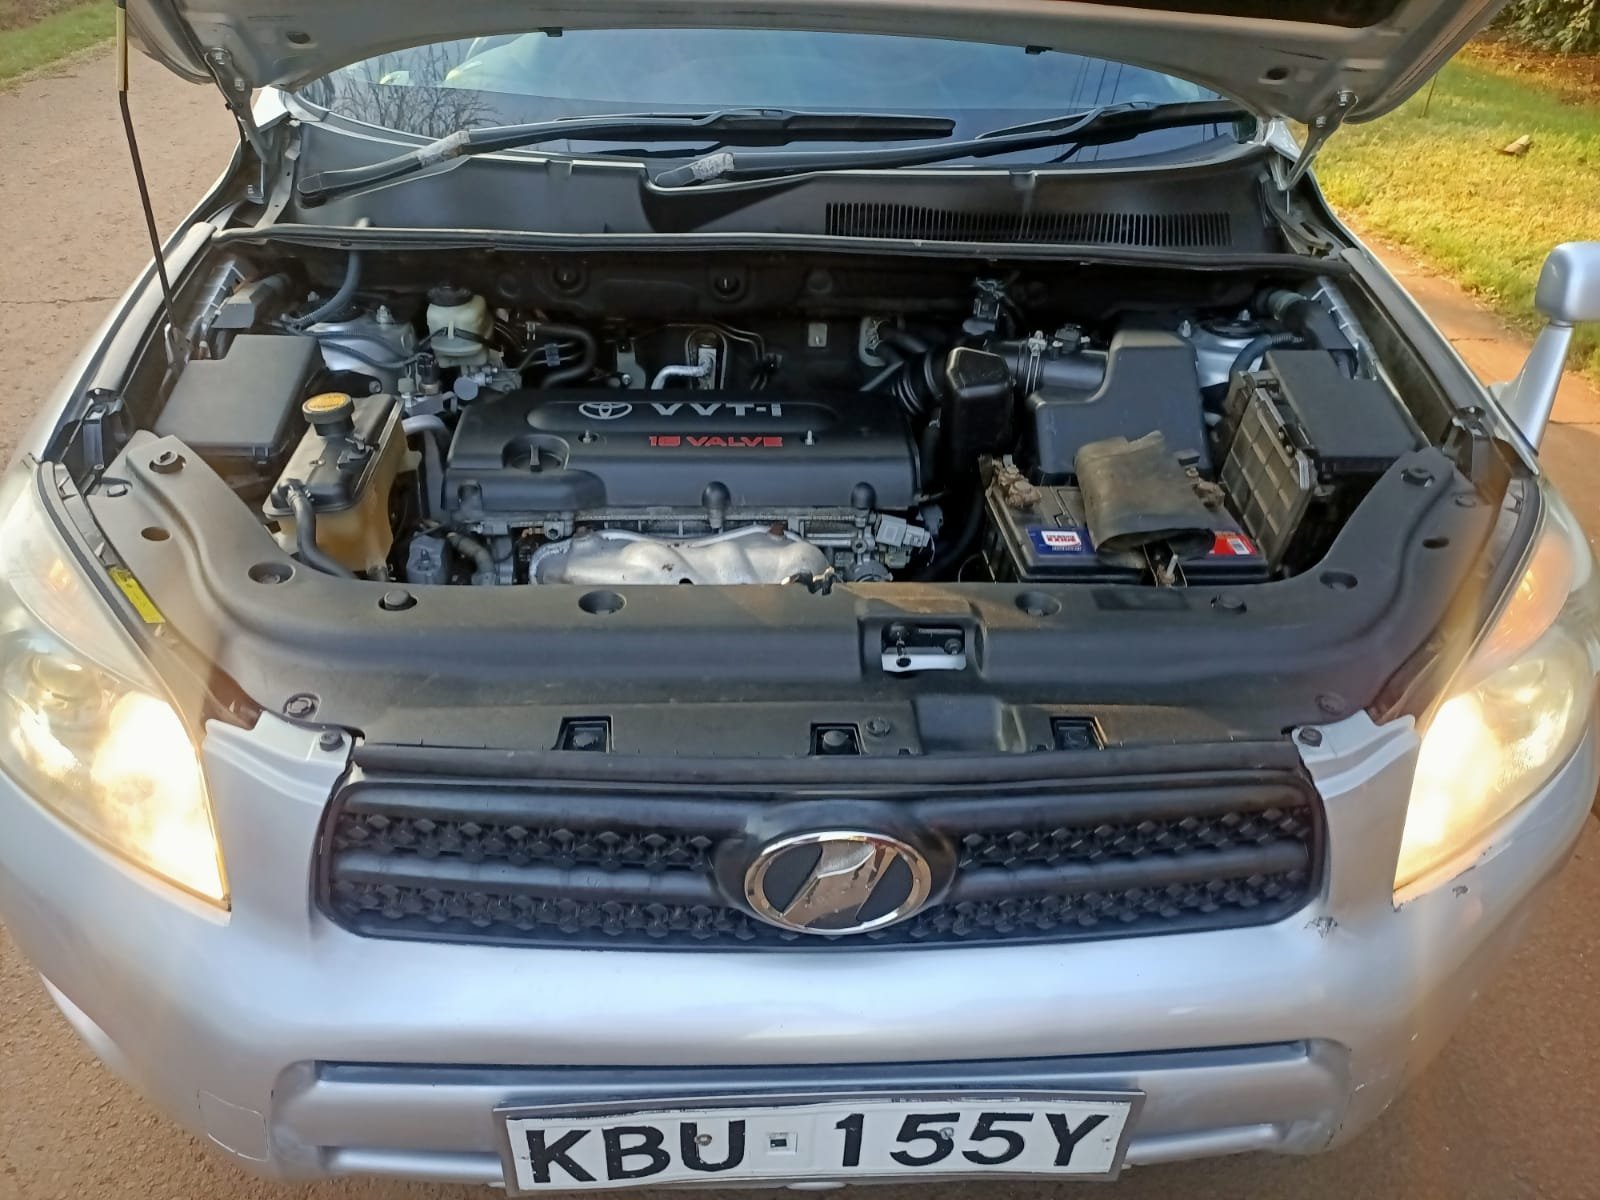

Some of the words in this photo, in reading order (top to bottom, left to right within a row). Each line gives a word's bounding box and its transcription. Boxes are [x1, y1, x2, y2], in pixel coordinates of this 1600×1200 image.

[686, 435, 783, 447] VALVE
[526, 1120, 746, 1183] KBU
[834, 1112, 1109, 1167] 155Y
